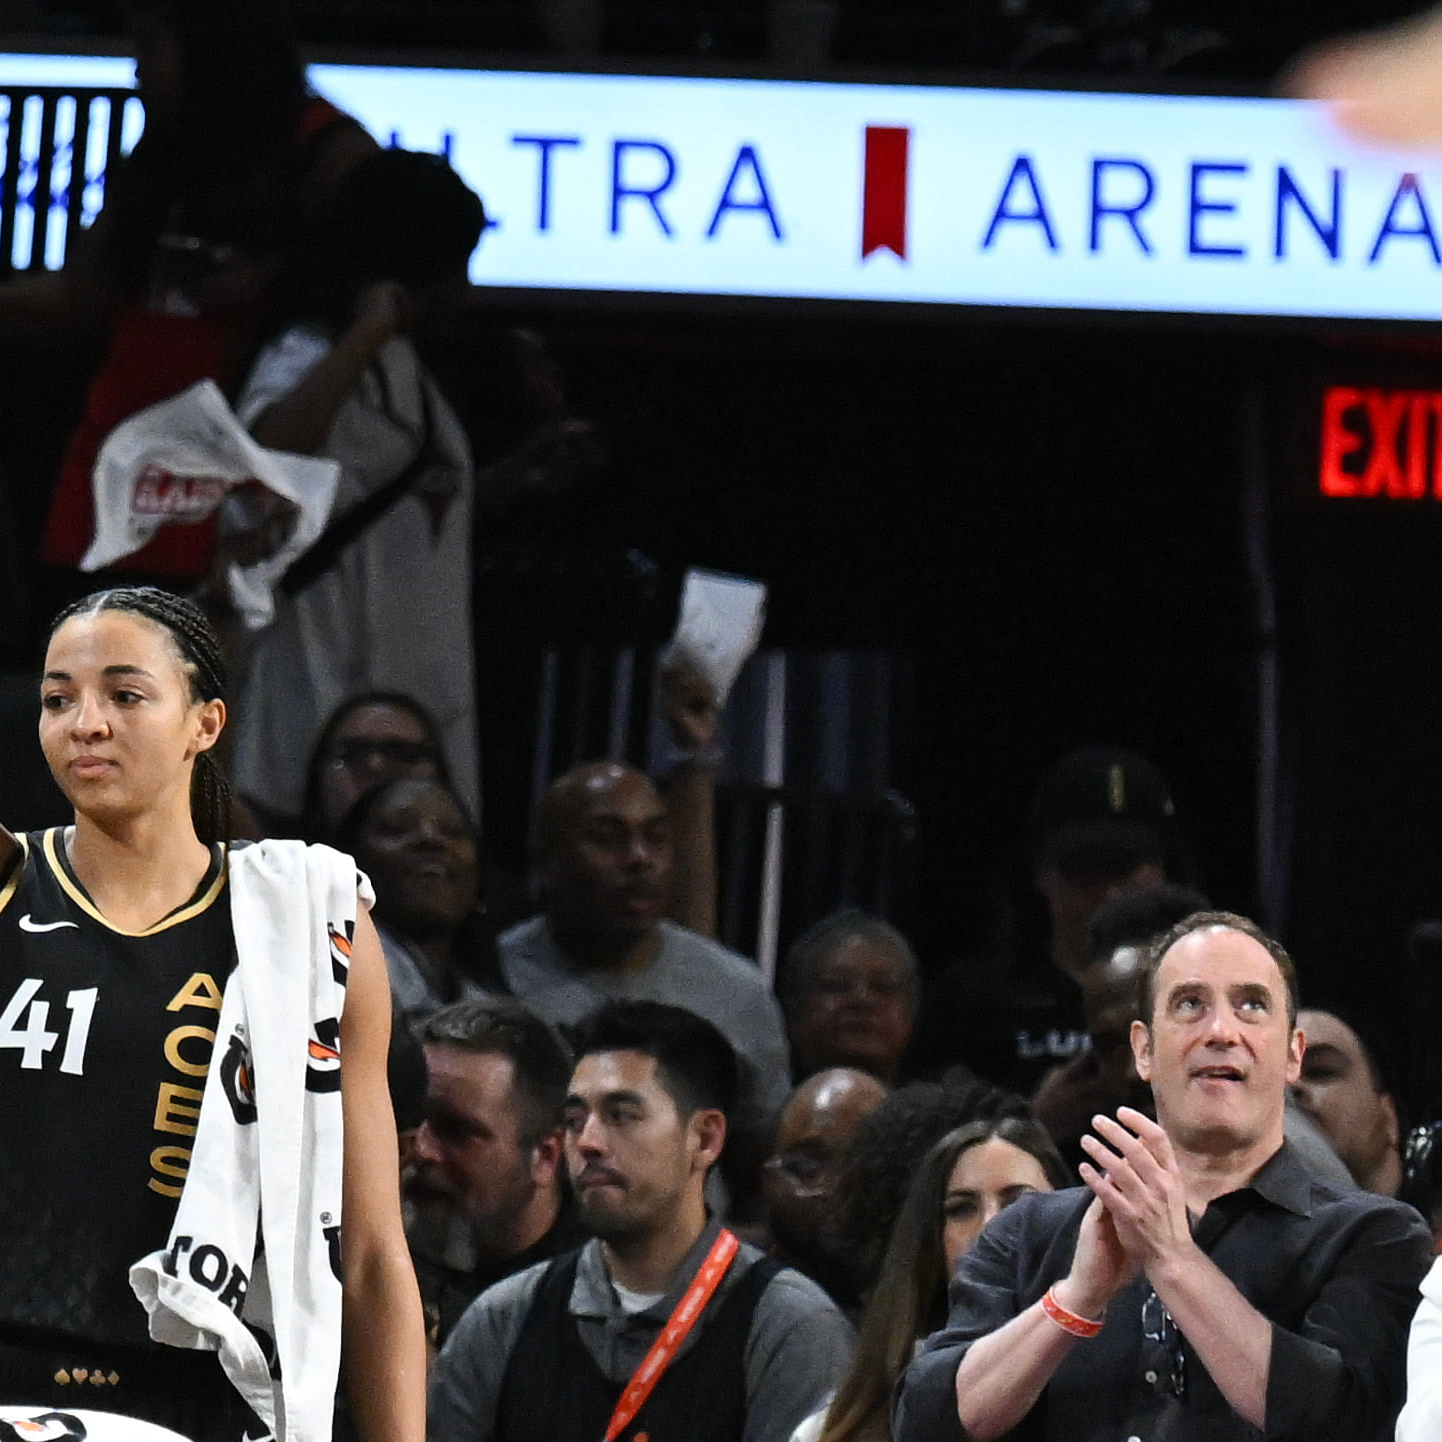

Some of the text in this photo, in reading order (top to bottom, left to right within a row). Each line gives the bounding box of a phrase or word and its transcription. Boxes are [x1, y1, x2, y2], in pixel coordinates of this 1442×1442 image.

[390, 131, 1442, 265] TRA ARENA
[147, 972, 224, 1199] ACES
